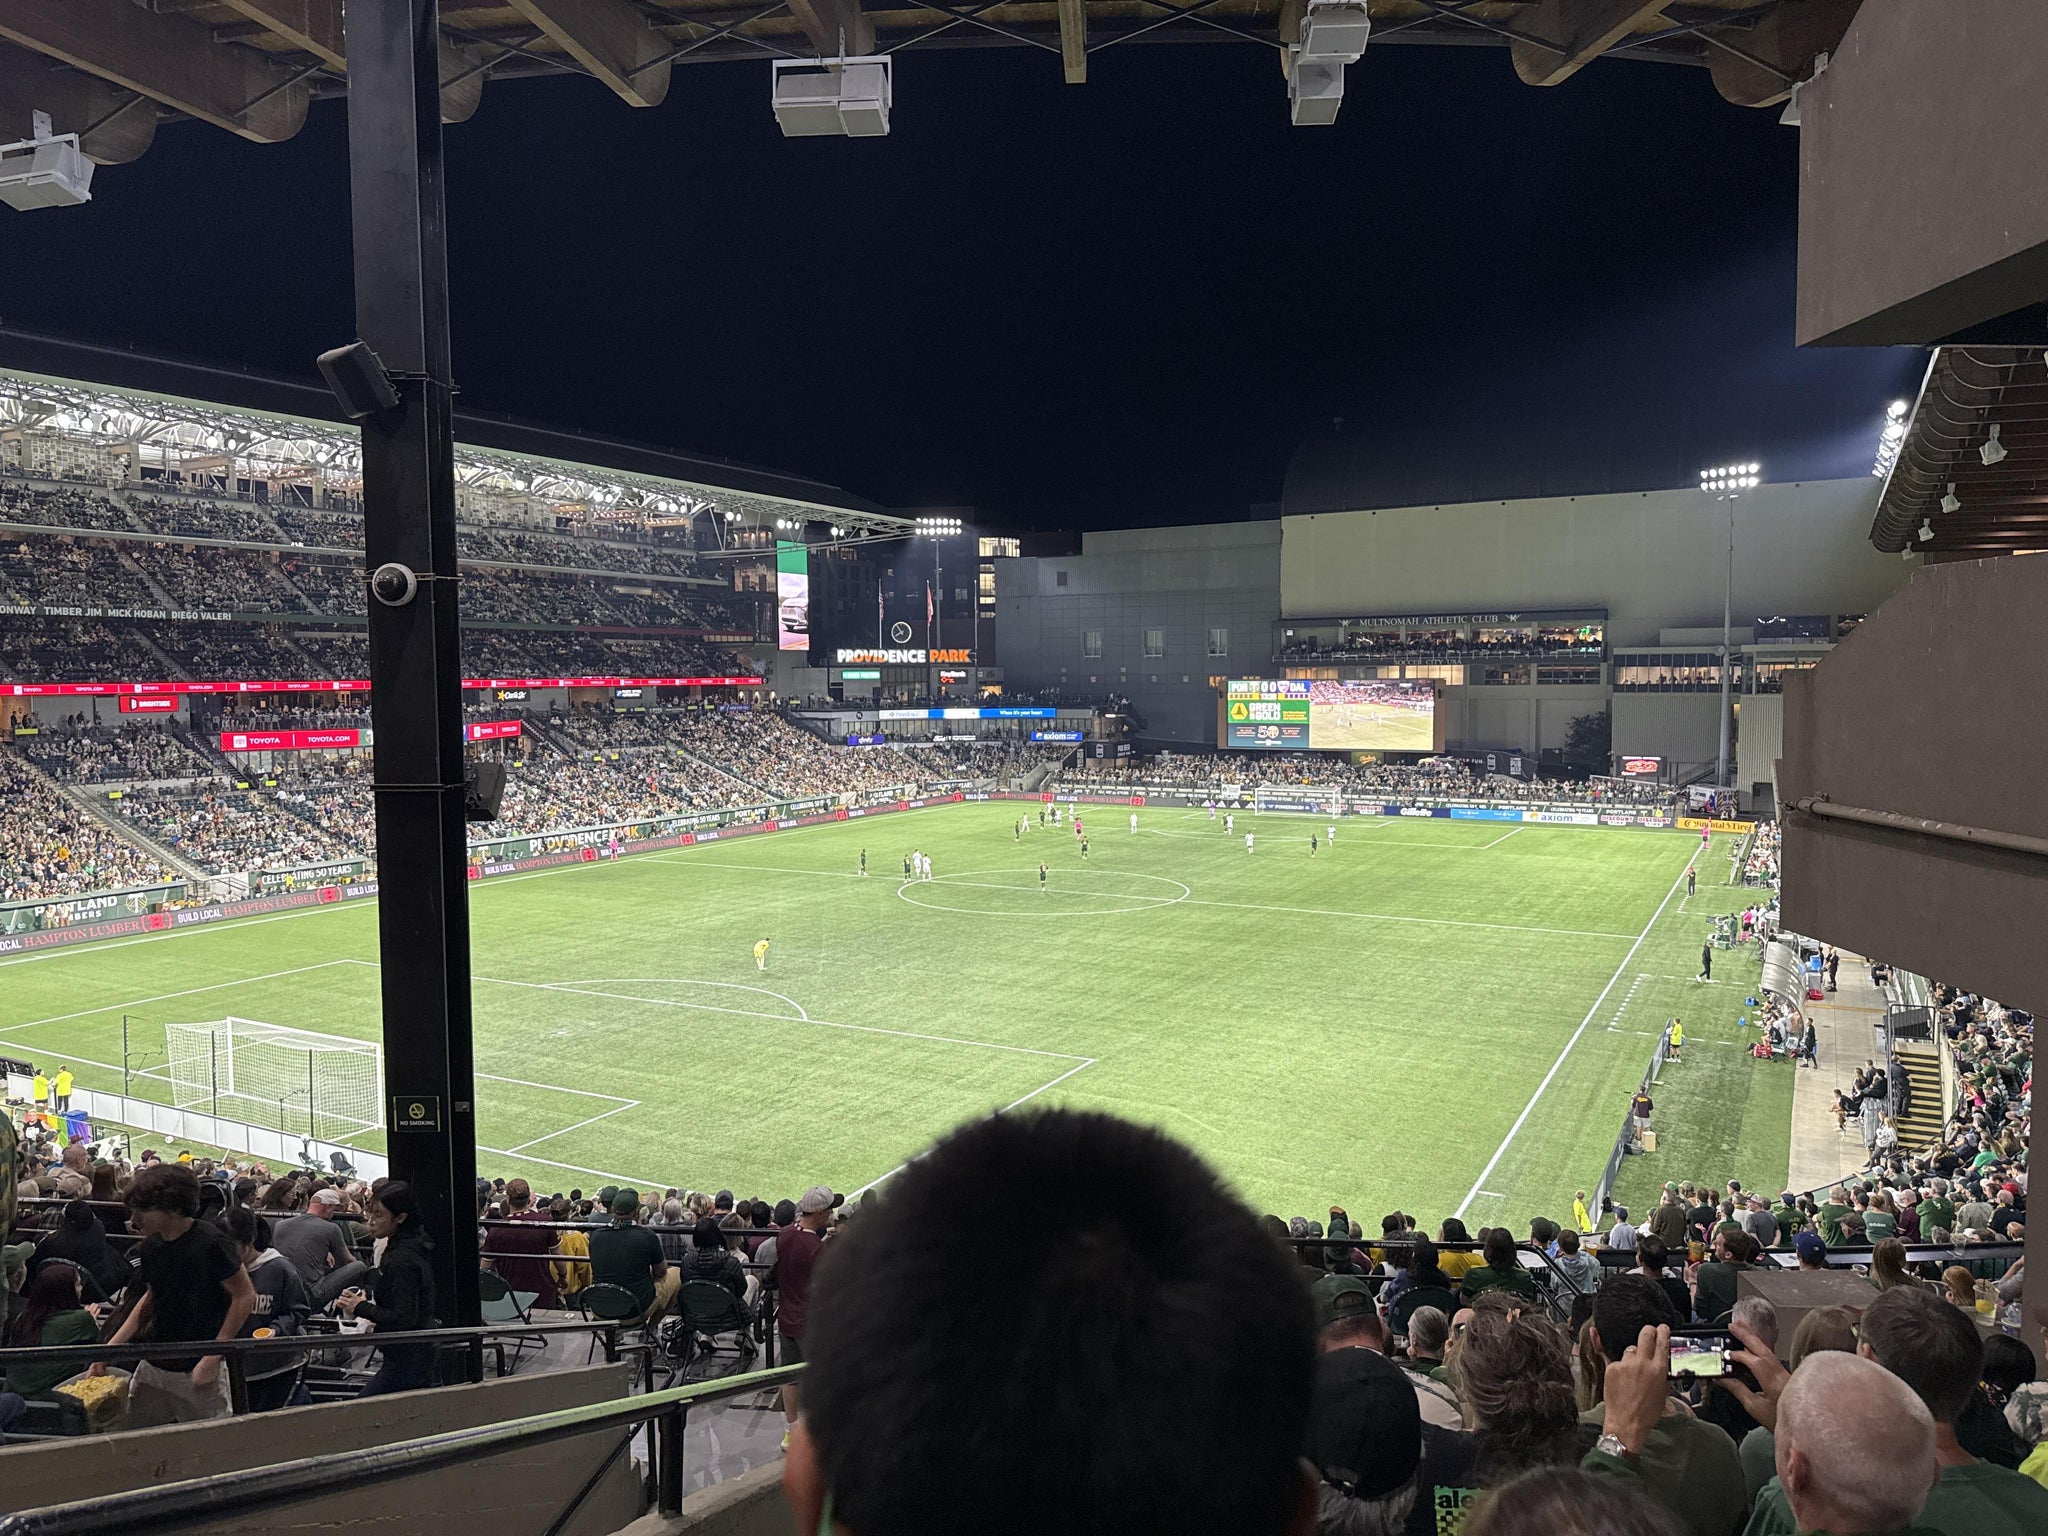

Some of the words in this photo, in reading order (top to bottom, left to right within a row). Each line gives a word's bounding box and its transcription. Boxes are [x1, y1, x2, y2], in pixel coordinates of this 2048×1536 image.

[44, 606, 82, 616] TIMBER
[85, 607, 102, 617] JIM
[108, 608, 132, 618] MICK
[134, 609, 166, 619] HOBAN
[171, 610, 198, 620] DIEGO
[200, 612, 232, 621] VALERI
[1360, 618, 1419, 627] MULTNOMAH
[1422, 615, 1468, 625] ATHLETIC
[1472, 615, 1498, 624] CLUB
[837, 649, 926, 663] PROVIDENCE
[929, 649, 971, 662] PARK
[1231, 683, 1248, 692] POR
[1289, 683, 1307, 692] DAL
[308, 735, 350, 743] TOYOTA.COM
[1541, 814, 1573, 823] axiom
[516, 858, 551, 870] HAMPTON
[551, 852, 580, 865] LUMBER
[316, 868, 327, 878] 50
[328, 864, 352, 876] YEARS
[24, 928, 87, 947] HAMPTON
[90, 920, 139, 938] LUMBER
[178, 911, 199, 923] BUILD
[200, 908, 222, 920] LOCAL
[223, 900, 274, 916] HAMPTON
[275, 894, 316, 907] LUMBER
[347, 886, 364, 897] BUILD
